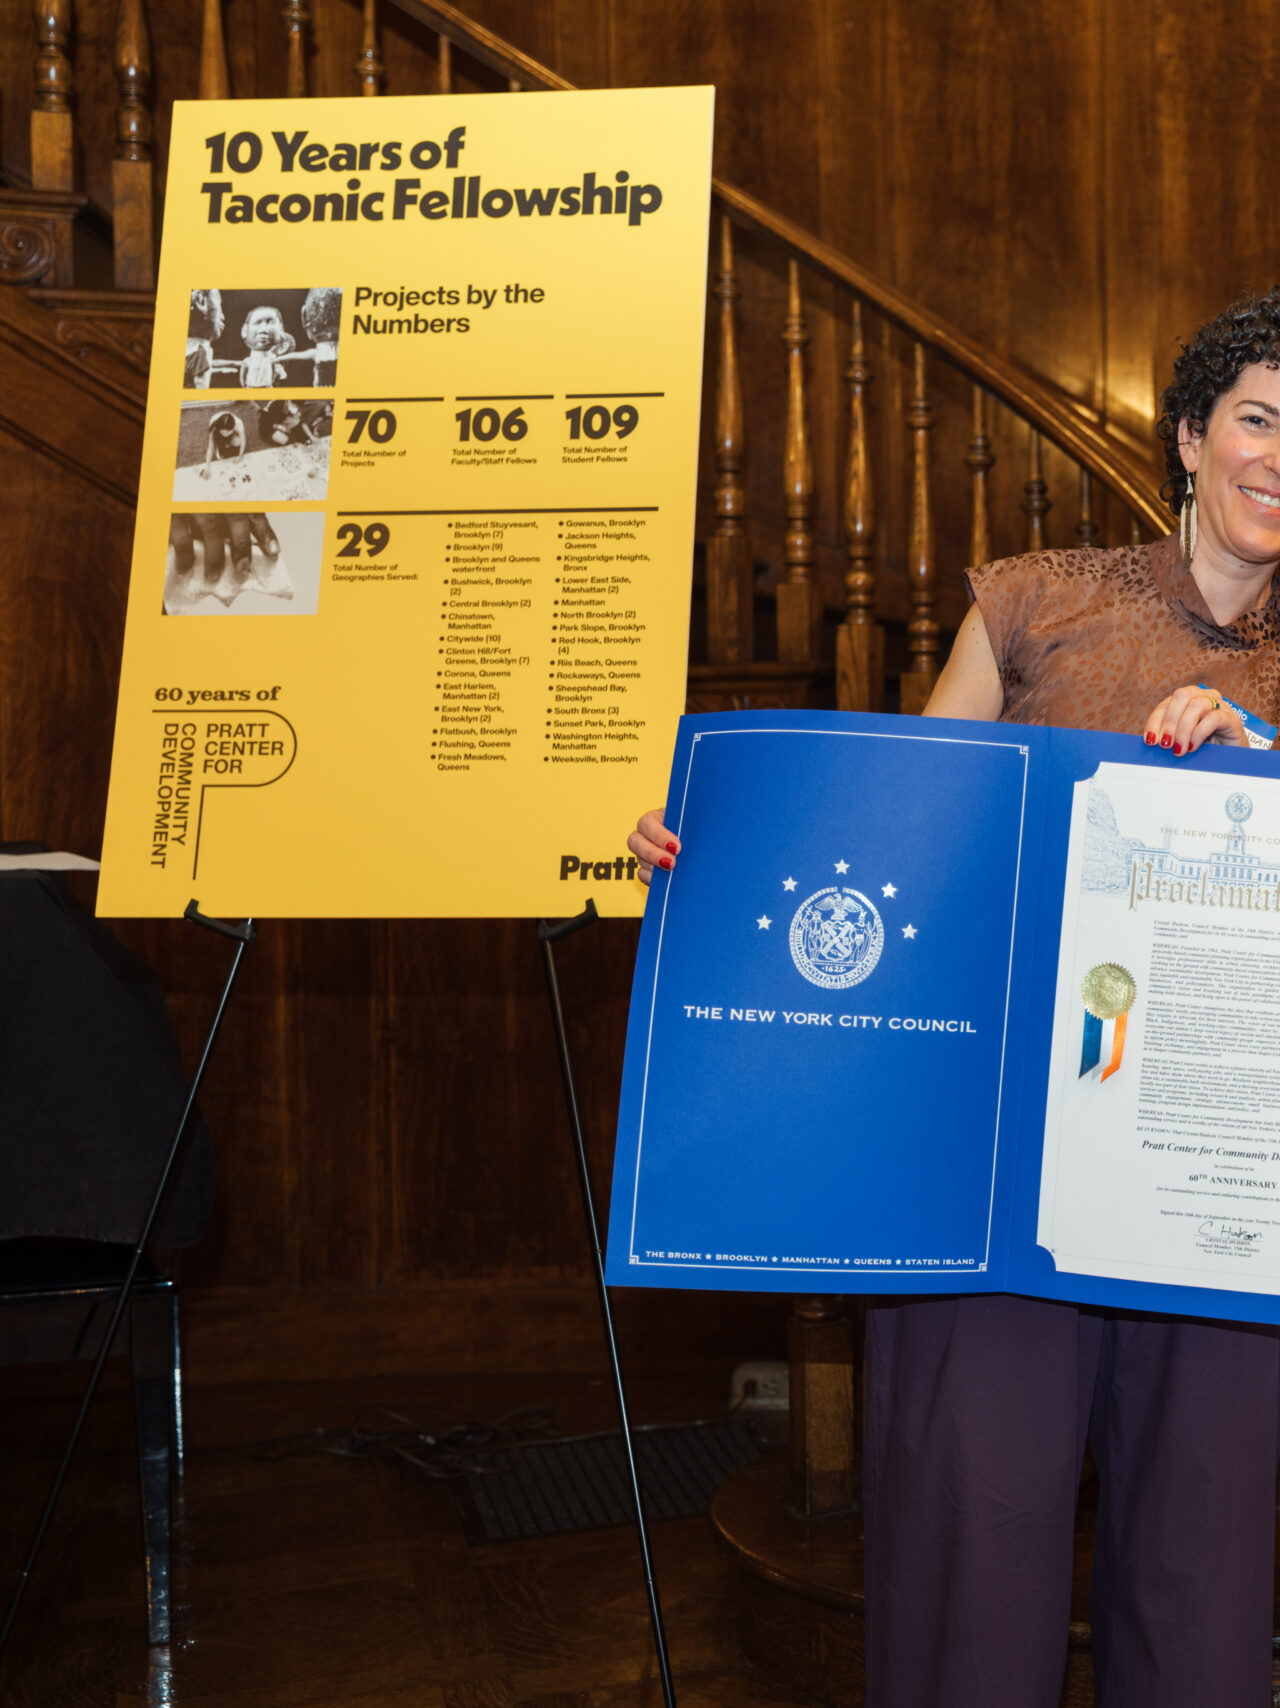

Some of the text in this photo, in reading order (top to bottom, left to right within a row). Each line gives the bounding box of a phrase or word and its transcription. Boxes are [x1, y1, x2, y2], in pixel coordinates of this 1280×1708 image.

[205, 126, 466, 173] 10 Years of
[200, 170, 662, 226] Taconic Fellowship
[354, 283, 544, 311] Projects by the
[352, 313, 469, 334] Numbers
[345, 409, 396, 443] 70
[455, 406, 528, 442] 106
[565, 404, 638, 439] 109
[508, 447, 516, 455] of
[340, 459, 374, 468] Projects
[451, 457, 504, 466] Faculty/Staff
[489, 521, 538, 529] Stuyvesant,
[608, 519, 645, 527] Brooklyn
[336, 522, 390, 557] 29
[454, 530, 503, 539] Brooklyn (7)
[601, 532, 636, 540] Heights,
[453, 542, 503, 552] Brooklyn (9)
[452, 556, 489, 564] Brooklyn
[563, 553, 650, 563] Kingsbridge Heights,
[331, 573, 384, 582] Geographies
[446, 634, 500, 643] Citywide (10)
[444, 669, 511, 678] Corona, Queens
[556, 671, 606, 680] Rockaways,
[154, 686, 281, 705] 60 years of
[556, 684, 627, 693] Sheepshead Bay,
[555, 694, 592, 703] Brooklyn
[206, 723, 269, 738] PRATT
[204, 740, 283, 756] CENTER
[202, 758, 242, 774] FOR
[551, 755, 637, 763] Weeksville, Brooklyn
[173, 722, 196, 845] COMMUNITY
[150, 723, 179, 868] DEVELOPMENT
[1159, 827, 1180, 836] THE
[1183, 830, 1208, 838] NEW
[1211, 832, 1240, 841] YORK
[559, 855, 637, 880] Pratt
[683, 1005, 976, 1033] THE NEW YORK CITY COUNCIL
[1141, 1140, 1165, 1150] Pratt
[1167, 1142, 1197, 1154] Center
[1198, 1145, 1214, 1156] for
[1216, 1147, 1269, 1162] Community
[1210, 1176, 1278, 1190] ANNIVERSARY
[645, 1250, 664, 1258] THE
[667, 1251, 701, 1259] BRONX
[715, 1253, 767, 1262] BROOKLYN
[781, 1256, 839, 1264] MANHATTAN
